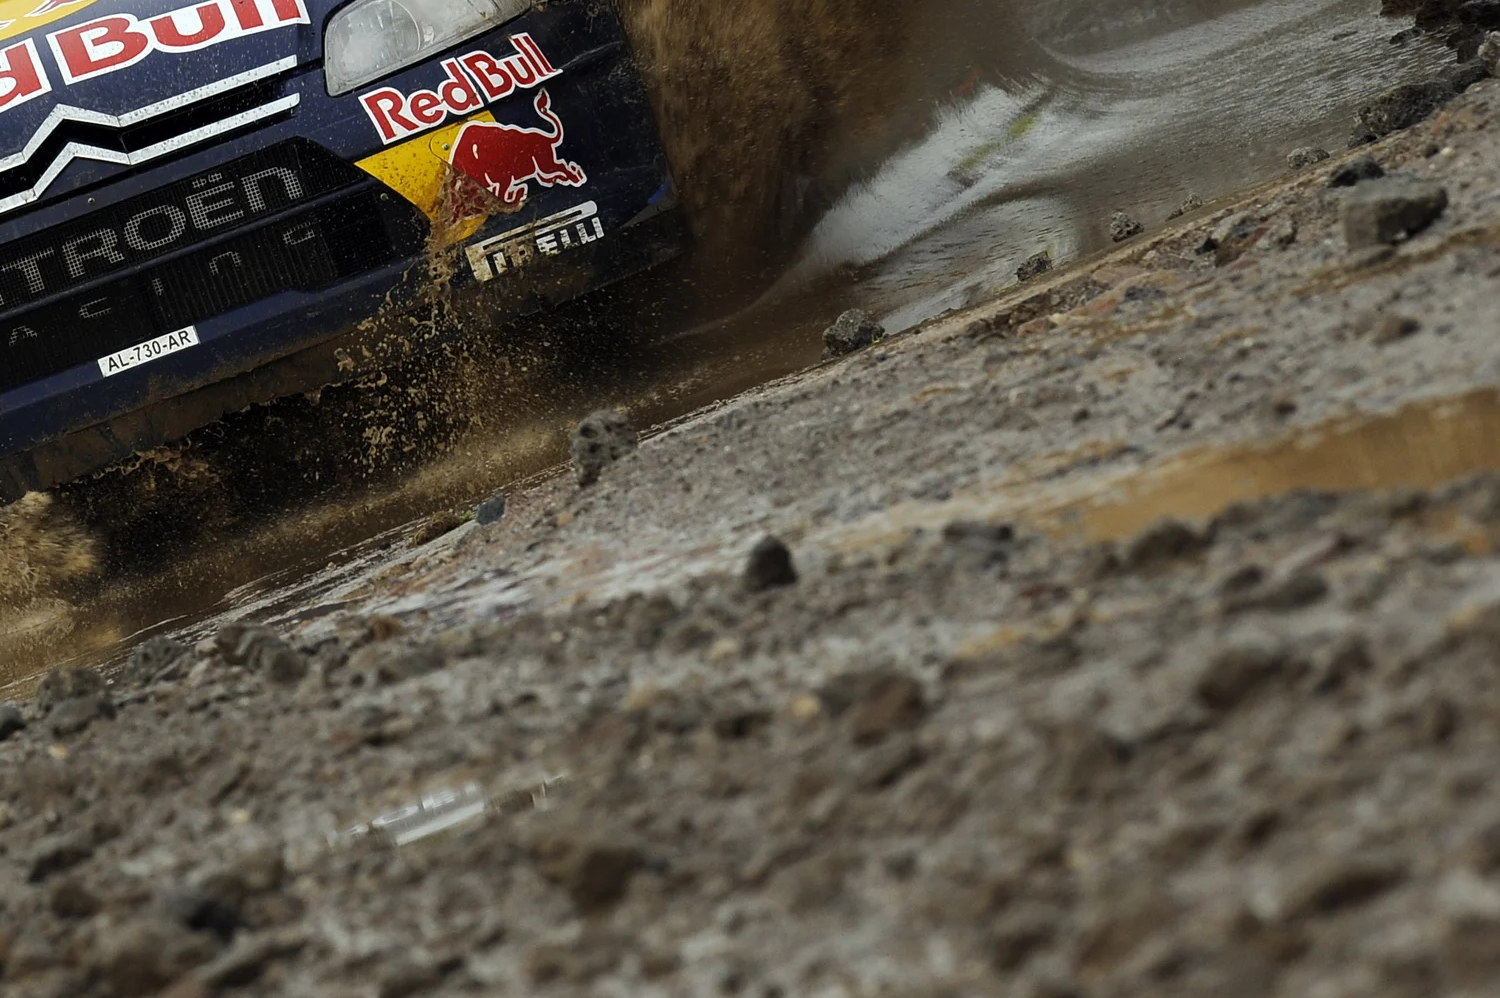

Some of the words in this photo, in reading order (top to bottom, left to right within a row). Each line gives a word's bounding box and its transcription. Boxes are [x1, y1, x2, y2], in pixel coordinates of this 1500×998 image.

[361, 60, 482, 142] Red
[461, 34, 559, 98] Bull
[106, 328, 193, 373] AL-730-AR
